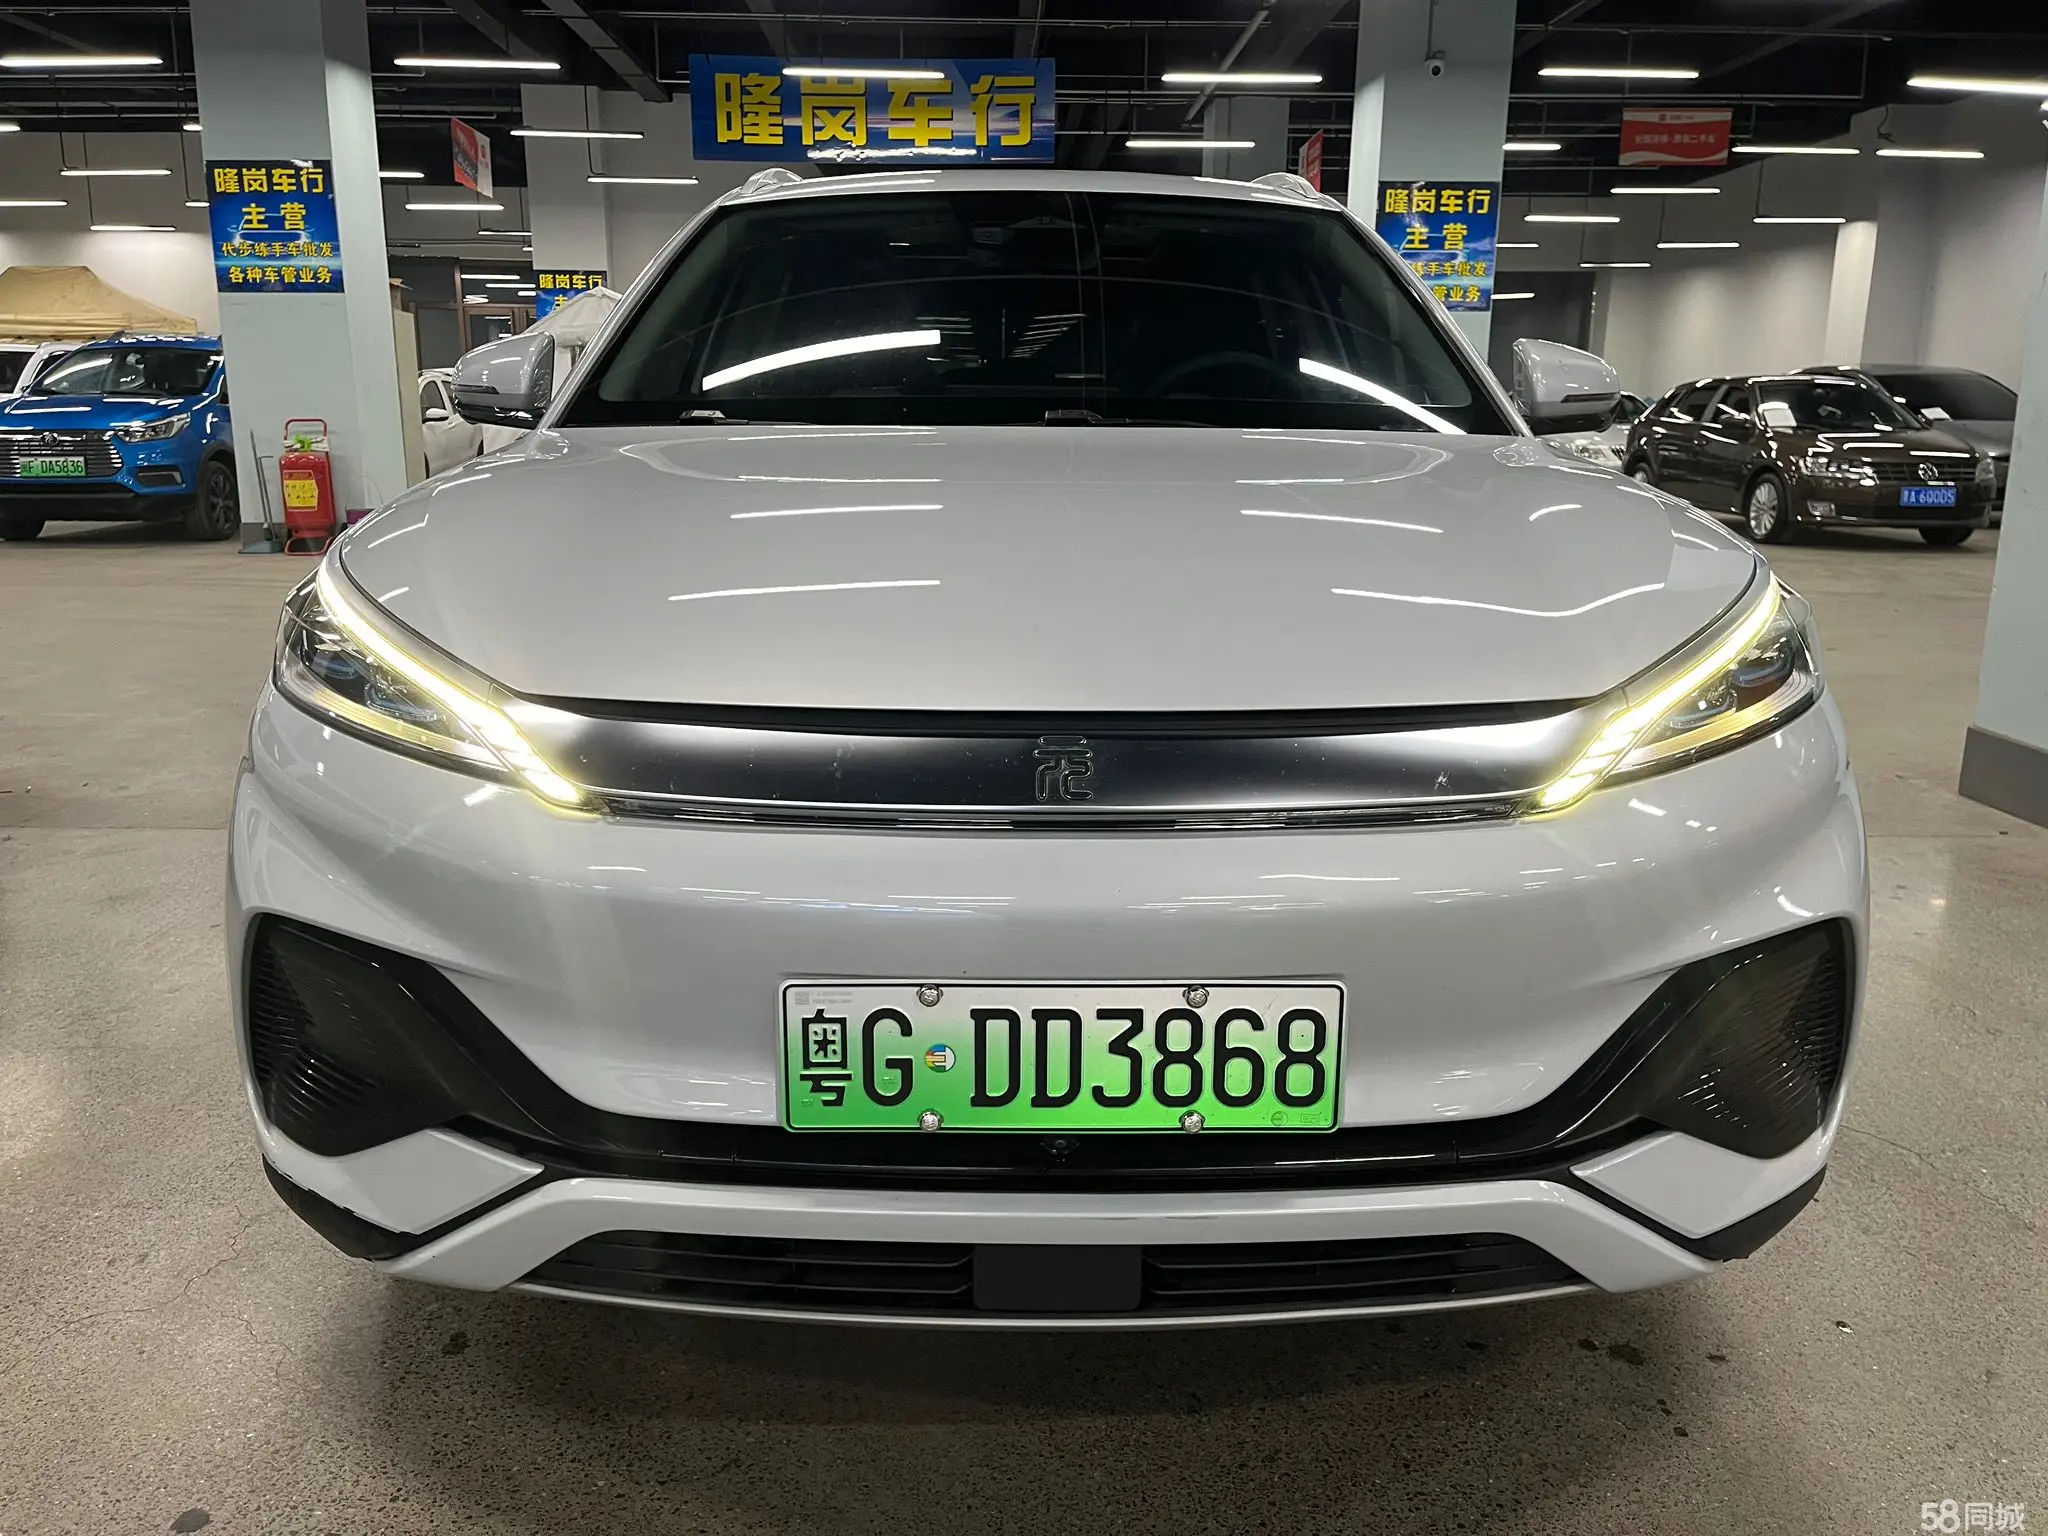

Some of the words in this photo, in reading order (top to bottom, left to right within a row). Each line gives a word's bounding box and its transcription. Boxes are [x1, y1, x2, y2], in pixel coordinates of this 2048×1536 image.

[715, 71, 1036, 146] 隆岗车行
[213, 167, 324, 193] 隆岗车行
[1384, 188, 1492, 214] 隆岗车行
[241, 202, 307, 230] 主营
[222, 241, 334, 258] 代步练手车批发
[1404, 223, 1468, 250] 主营
[229, 265, 333, 284] 各种车管业务
[539, 274, 602, 289] 隆岗车行
[40, 460, 84, 474] DA5836
[1033, 735, 1093, 802] 元
[800, 1007, 914, 1108] 粤G
[969, 1007, 1329, 1108] DD3868
